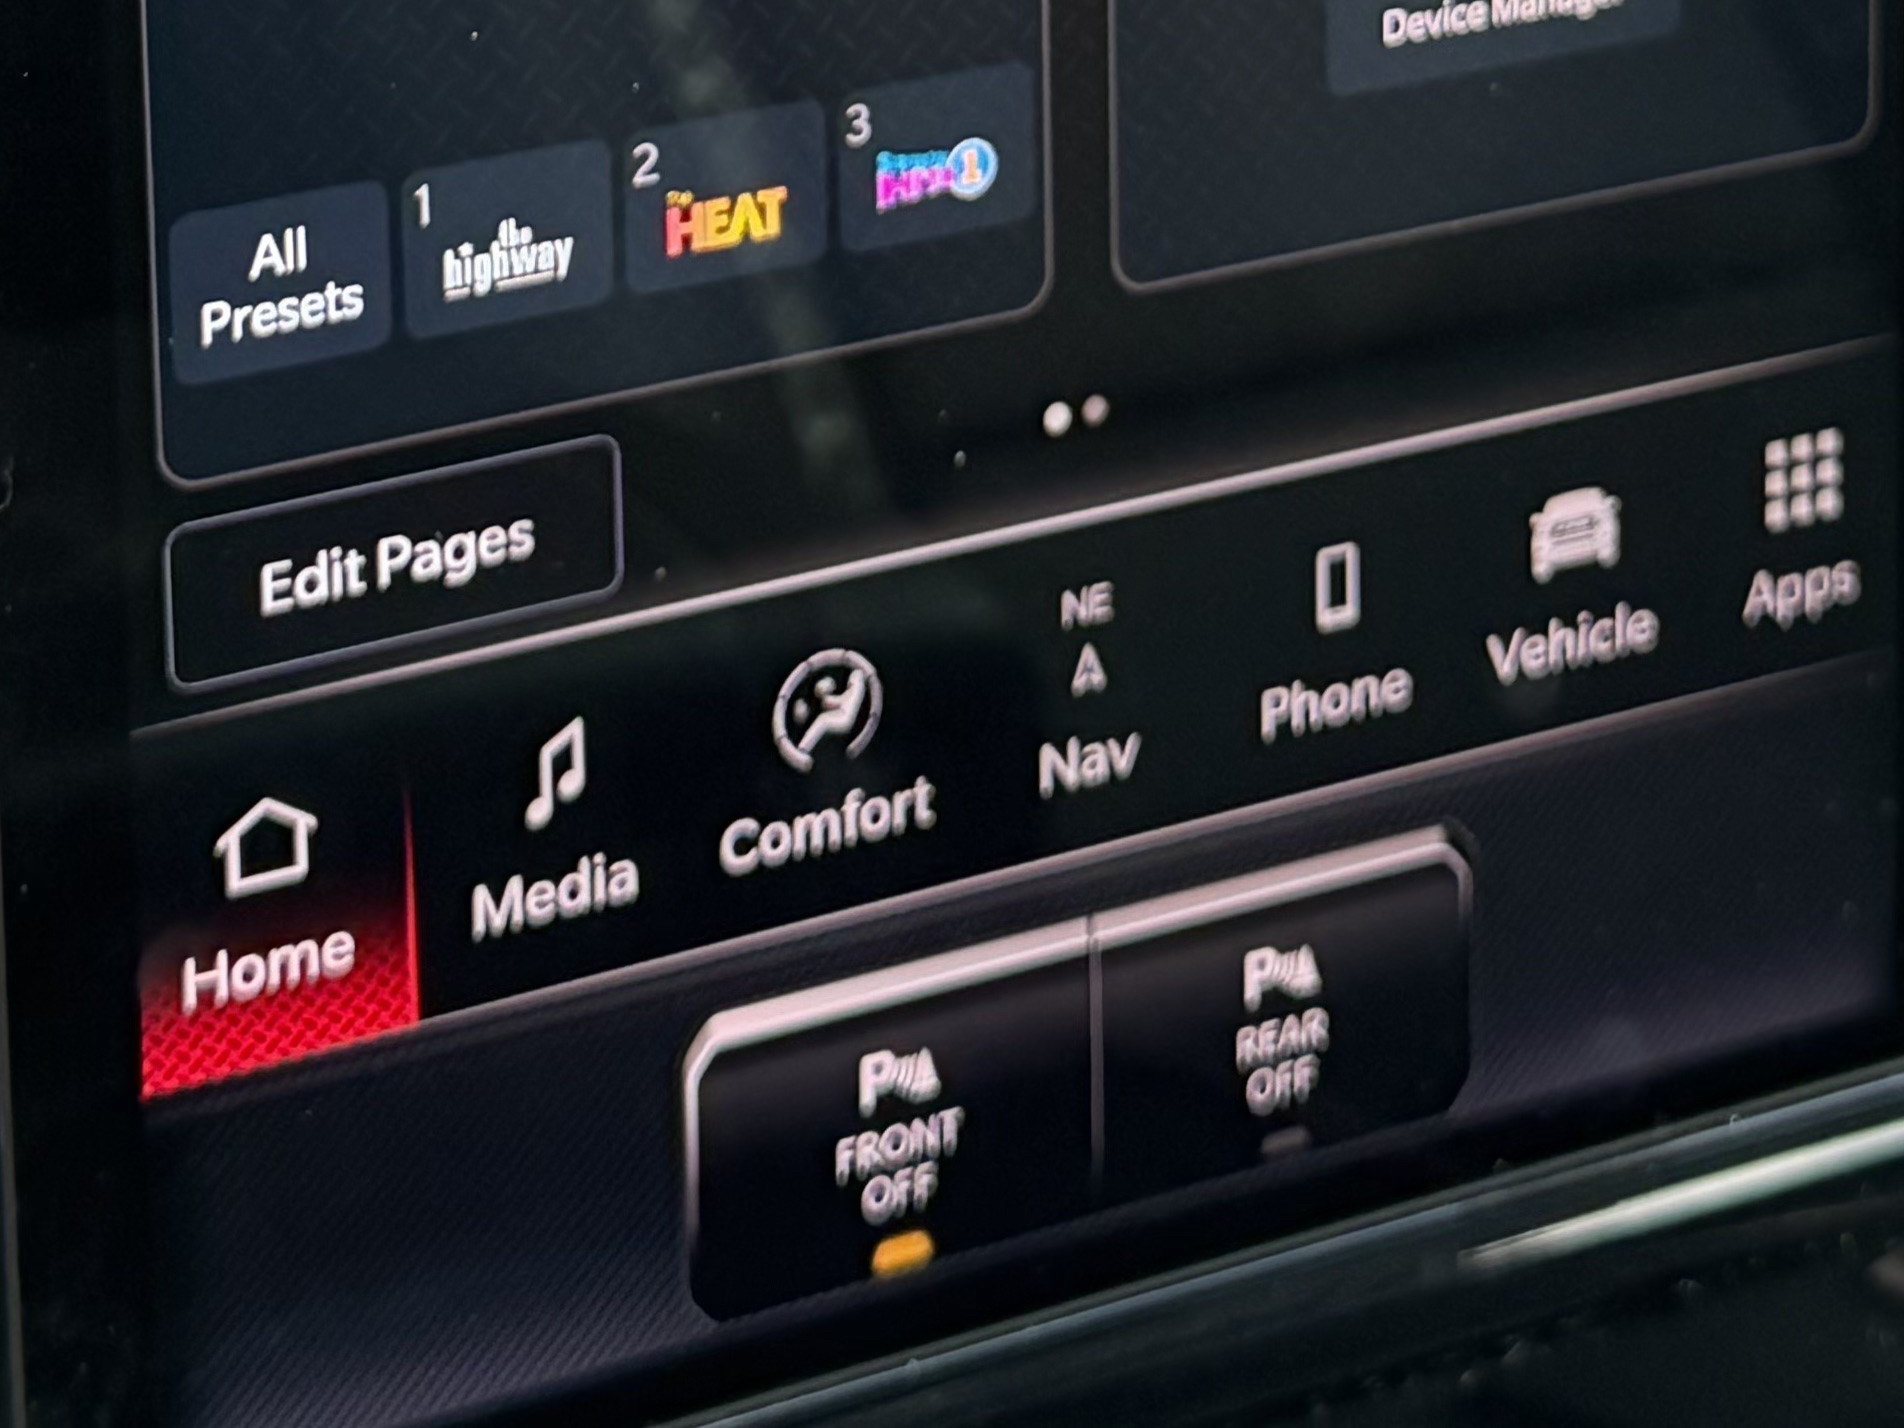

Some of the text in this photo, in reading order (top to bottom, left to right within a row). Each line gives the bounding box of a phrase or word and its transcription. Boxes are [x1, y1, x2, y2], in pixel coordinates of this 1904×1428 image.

[846, 102, 872, 147] 3
[632, 143, 660, 189] 2
[413, 183, 432, 230] 1
[665, 185, 788, 259] HEAT
[248, 226, 307, 280] All
[443, 236, 574, 297] highway
[200, 283, 364, 348] Presets
[258, 517, 536, 618] Edit Pages
[1742, 559, 1862, 632] Apps
[1060, 580, 1113, 630] NE
[1485, 601, 1661, 687] Vehicle
[1259, 666, 1414, 744] Phone
[1037, 731, 1142, 799] Nav
[718, 776, 938, 878] Comfort
[471, 854, 641, 943] Media
[180, 928, 356, 1017] Home
[1235, 1006, 1330, 1072] REAR
[1245, 1055, 1321, 1117] OFF
[836, 1106, 965, 1187] FRONT
[860, 1160, 939, 1227] OFF
